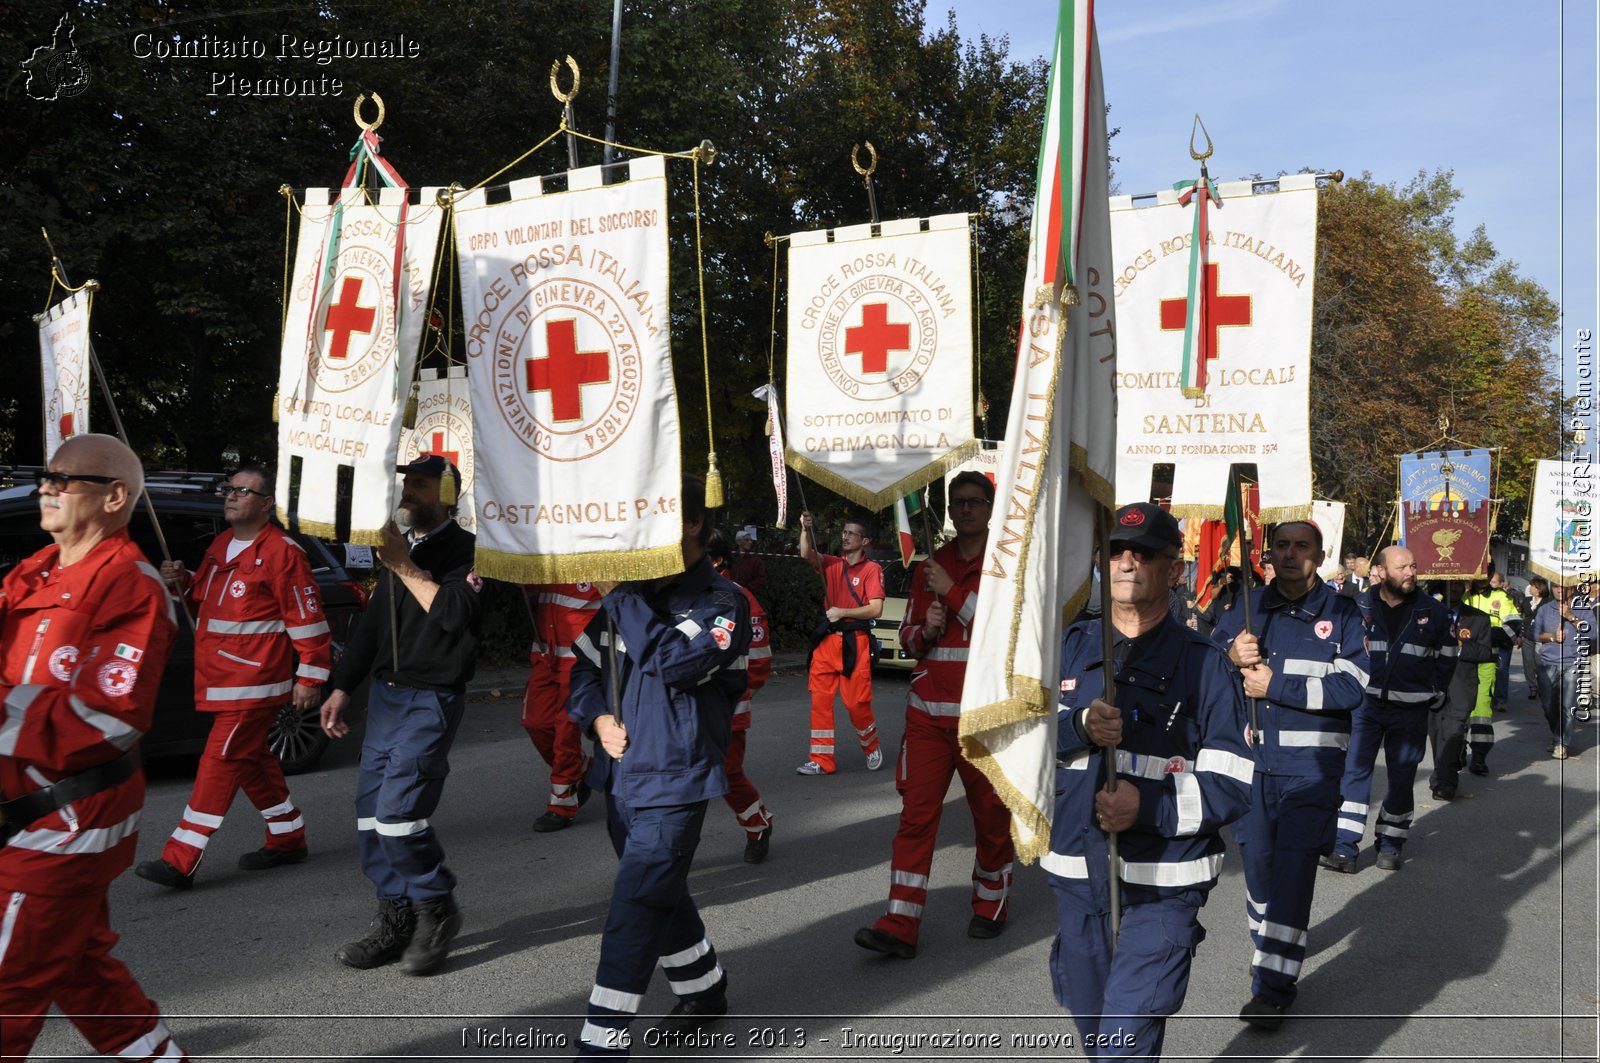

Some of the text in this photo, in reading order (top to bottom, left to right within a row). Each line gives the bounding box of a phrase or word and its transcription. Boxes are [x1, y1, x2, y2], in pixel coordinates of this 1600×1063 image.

[469, 209, 658, 251] ORPO VOLONTARI DEL SOCCORSO
[1159, 232, 1217, 257] ROSA
[1222, 231, 1307, 288] ITALIANA
[466, 277, 512, 358] CROCE
[511, 244, 584, 285] ROSSA
[801, 252, 957, 330] CROCE ROSSA ITALIANA
[821, 277, 935, 396] CONVENZIONE DI GINEVRA 22 AGOSTO 1864
[498, 284, 638, 452] CONVENZIONE DI GINEVRA 22 AGOSTO 1864
[1219, 365, 1296, 387] LOCALE
[1195, 394, 1211, 408] DI
[320, 419, 331, 434] DI
[336, 404, 392, 426] LOCALE
[803, 407, 952, 428] SOTTOCOMITATO DI
[1142, 412, 1268, 434] SANTENA
[288, 429, 369, 458] MONCALIERI
[805, 432, 951, 453] CARMAGNOLA
[1126, 445, 1162, 455] ANNO
[1166, 445, 1177, 455] DI
[1181, 445, 1257, 455] FONDAZIONE
[982, 392, 1048, 579] ITALIANA
[482, 500, 628, 525] CASTAGNOLE
